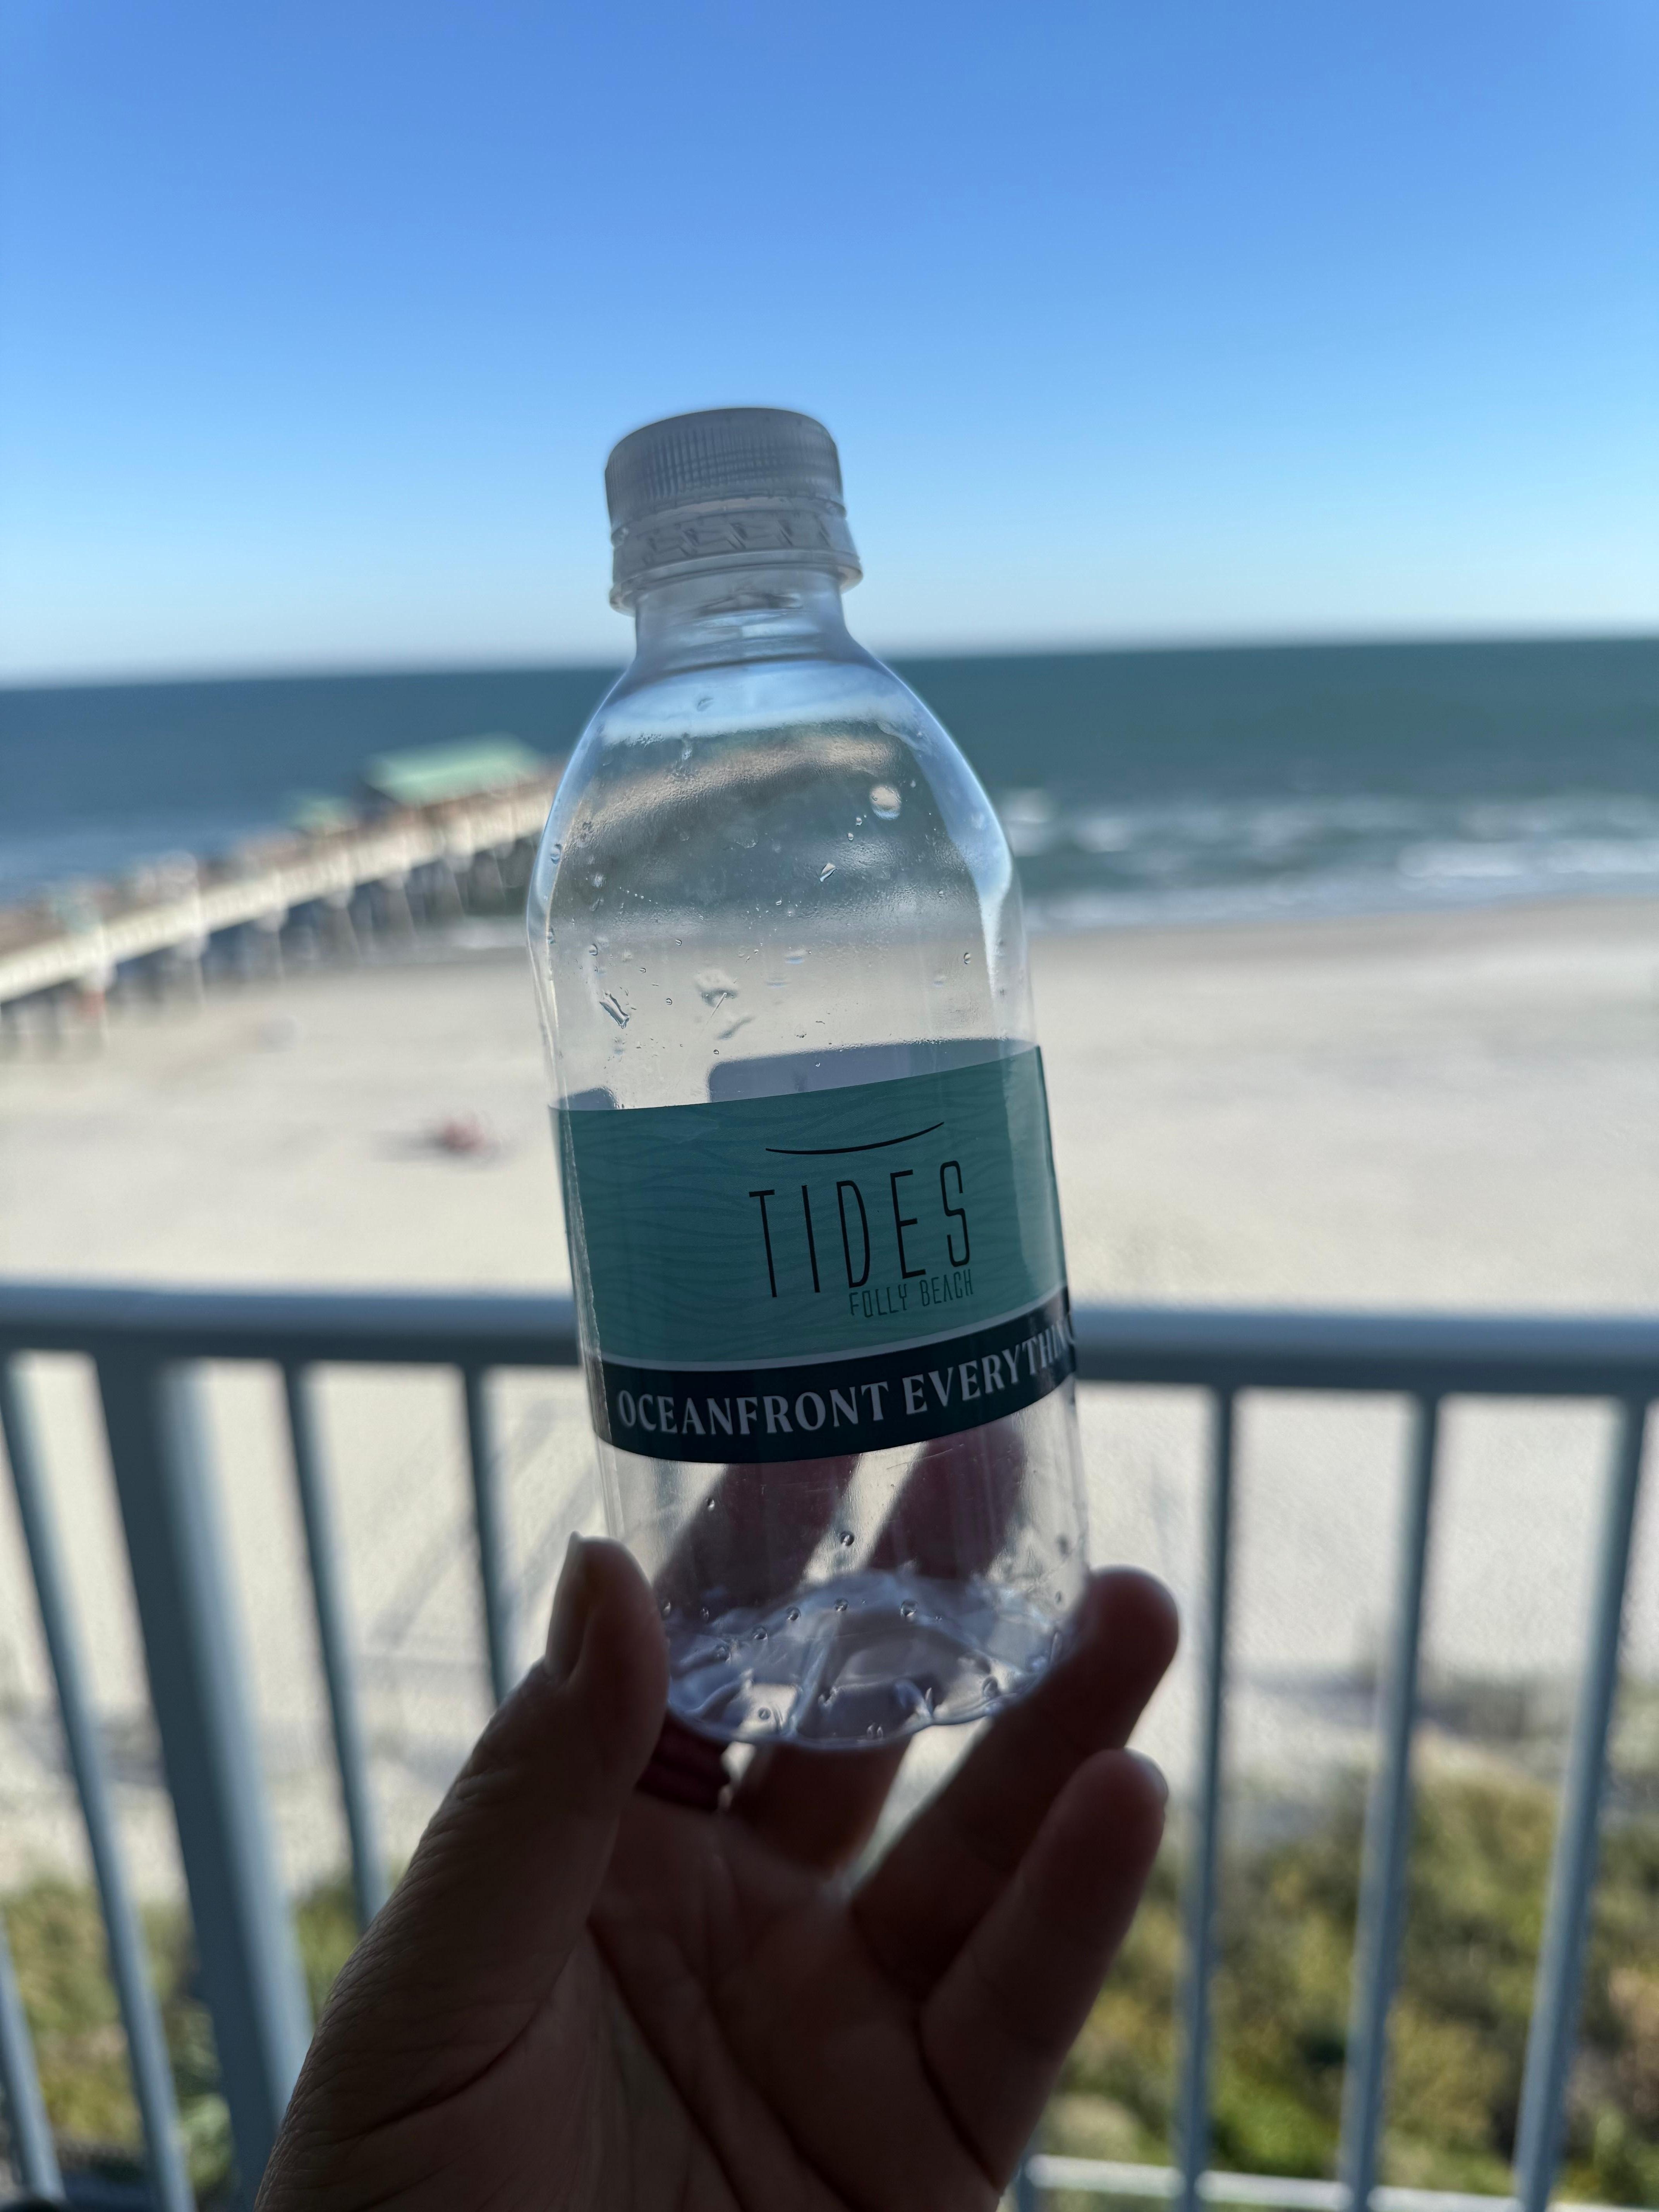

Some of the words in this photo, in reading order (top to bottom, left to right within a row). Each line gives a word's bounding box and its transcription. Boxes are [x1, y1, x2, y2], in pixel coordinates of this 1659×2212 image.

[749, 1160, 970, 1297] TIDES
[850, 1283, 907, 1318] FOLLY
[919, 1268, 974, 1307] BEACH
[618, 1381, 889, 1435] OCEANFRONT
